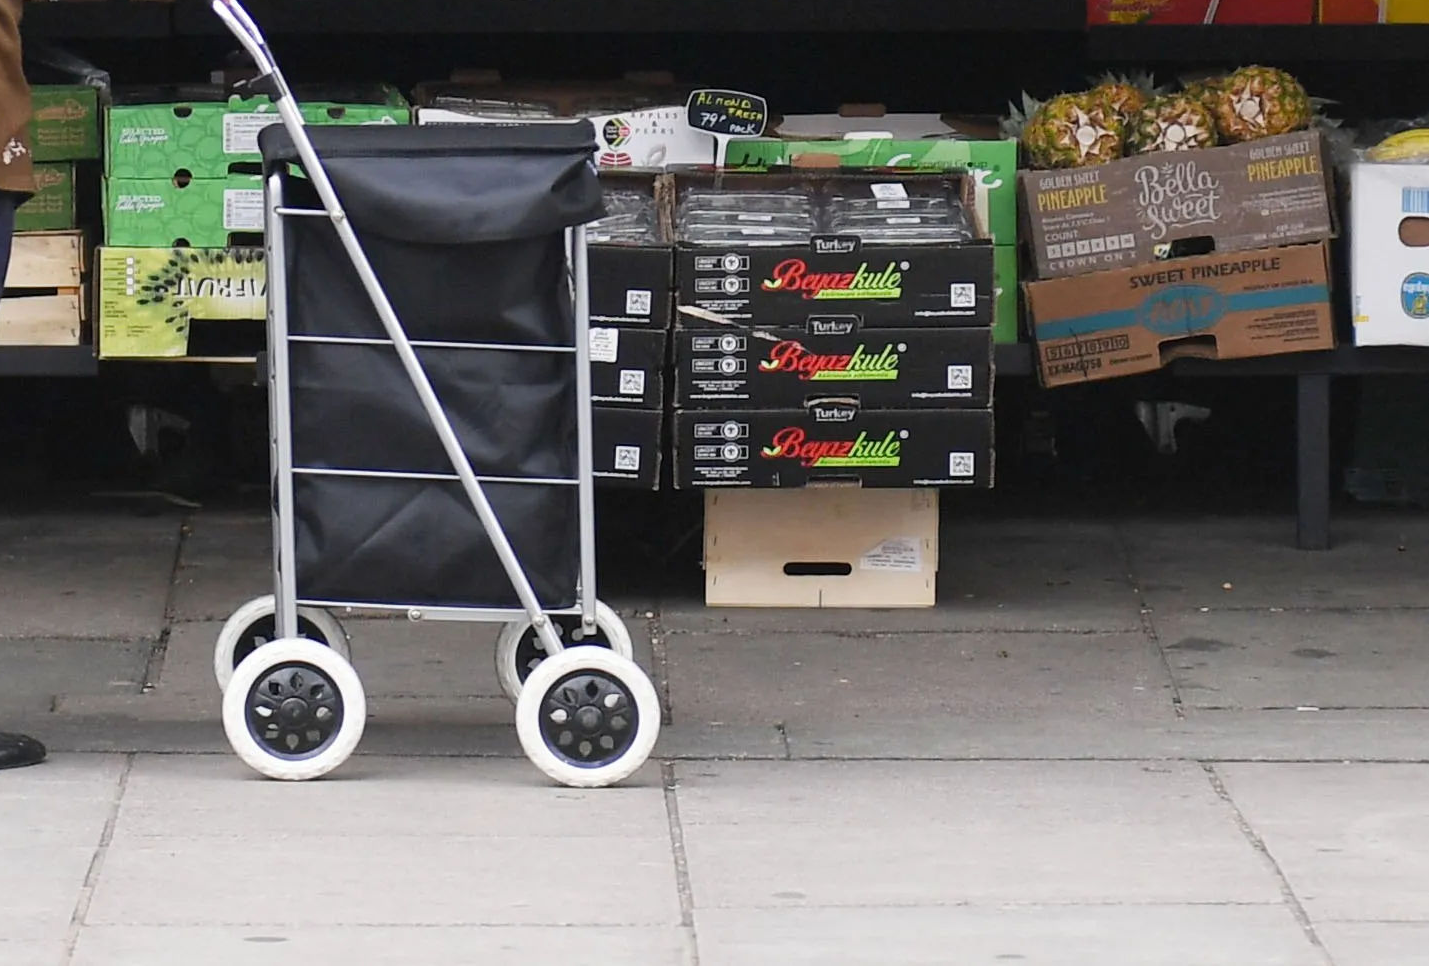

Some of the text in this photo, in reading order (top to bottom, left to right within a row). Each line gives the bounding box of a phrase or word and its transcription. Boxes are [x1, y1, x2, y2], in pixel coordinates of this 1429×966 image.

[696, 92, 752, 109] ALMOND
[1249, 141, 1310, 160] GOLDEN SWEET
[1039, 170, 1100, 191] GOLDEN SWEET
[1247, 154, 1318, 183] PINEAPPLE
[1134, 160, 1220, 207] Bella
[1037, 184, 1109, 212] PINEAPPLE
[815, 239, 855, 252] Turkey
[762, 258, 902, 300] Beyazkule
[1130, 258, 1280, 290] SWEET PINEAPPLE
[812, 320, 853, 333] Turkey
[758, 340, 899, 381] Beyazkule
[815, 407, 856, 421] Turkey
[761, 426, 901, 467] Beyazkule
